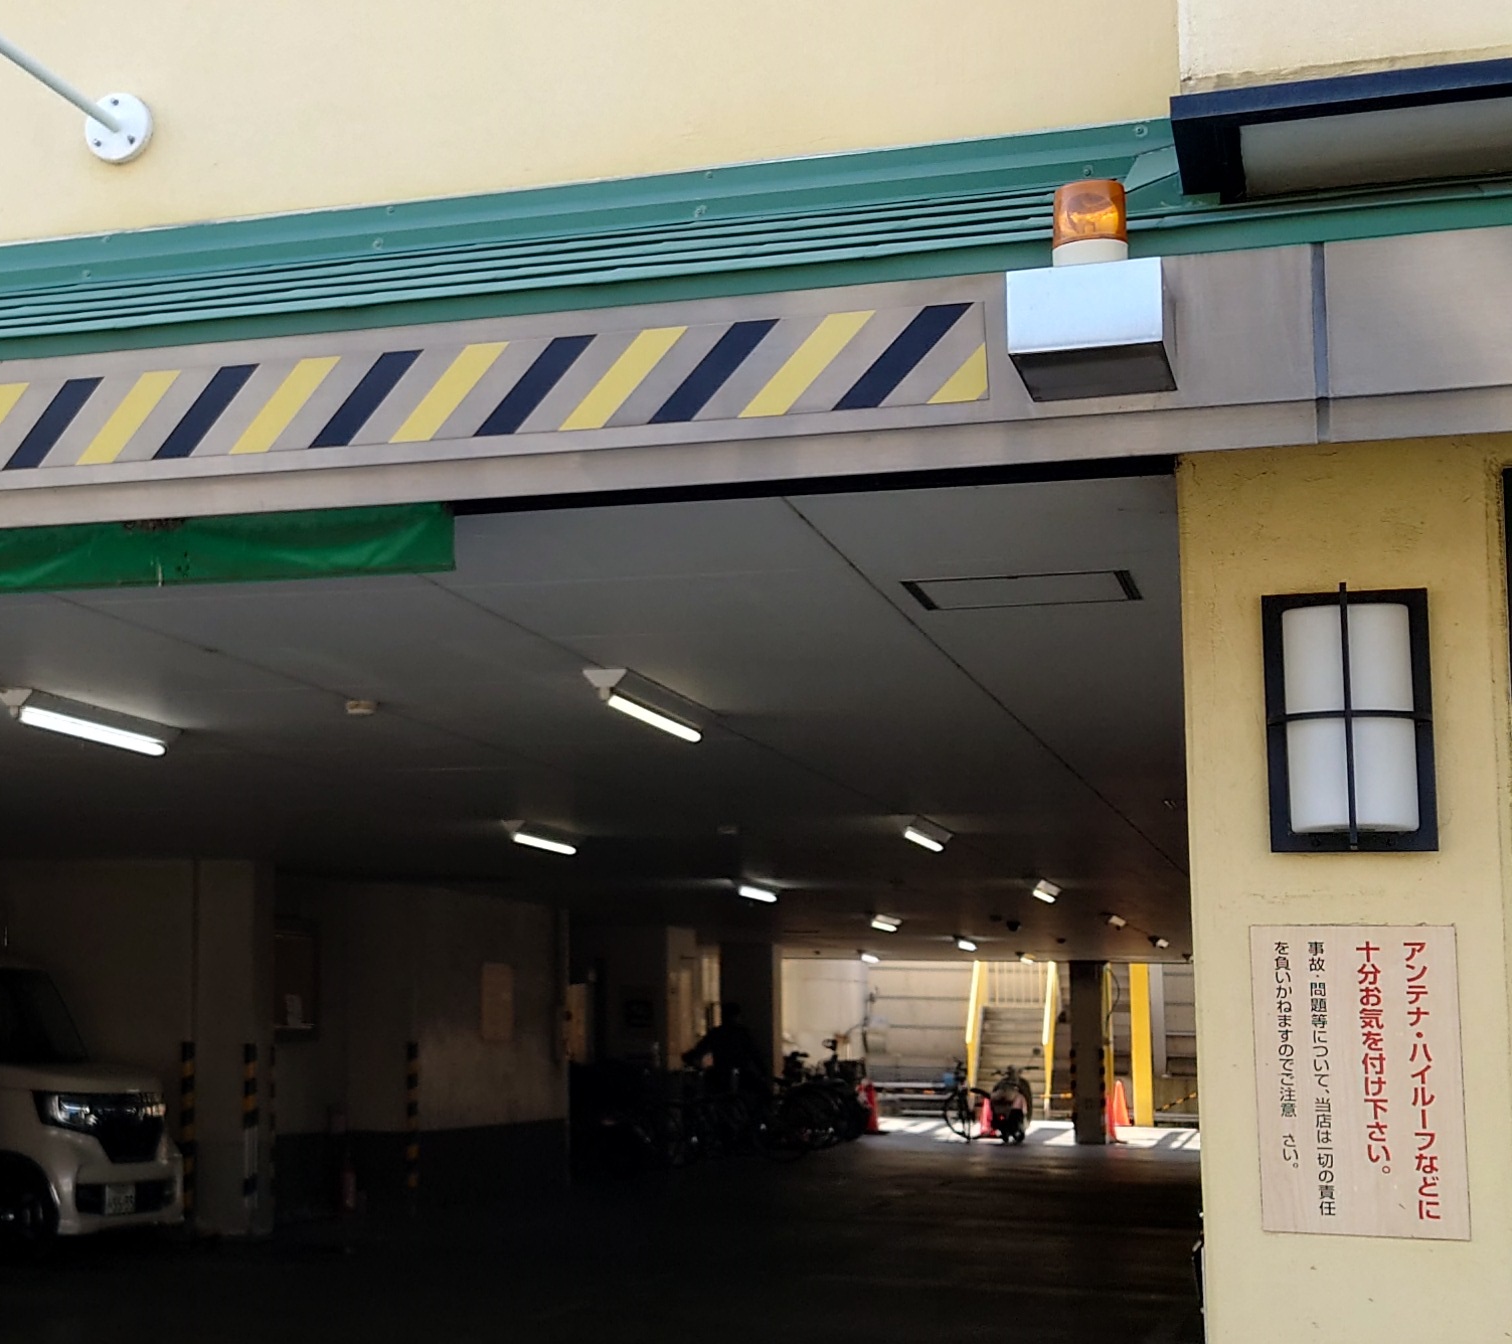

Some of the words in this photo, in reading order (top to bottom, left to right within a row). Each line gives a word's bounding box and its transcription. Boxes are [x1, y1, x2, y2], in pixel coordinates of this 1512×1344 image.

[1274, 941, 1299, 1169] を負いかねますのでご注意さい。
[1308, 941, 1336, 1217] 事故・問題等について、当店は一切の責任
[1355, 940, 1391, 1175] 十分お気を付け下さい。
[1403, 940, 1441, 1220] アンテナ・ハイルーフなどに
